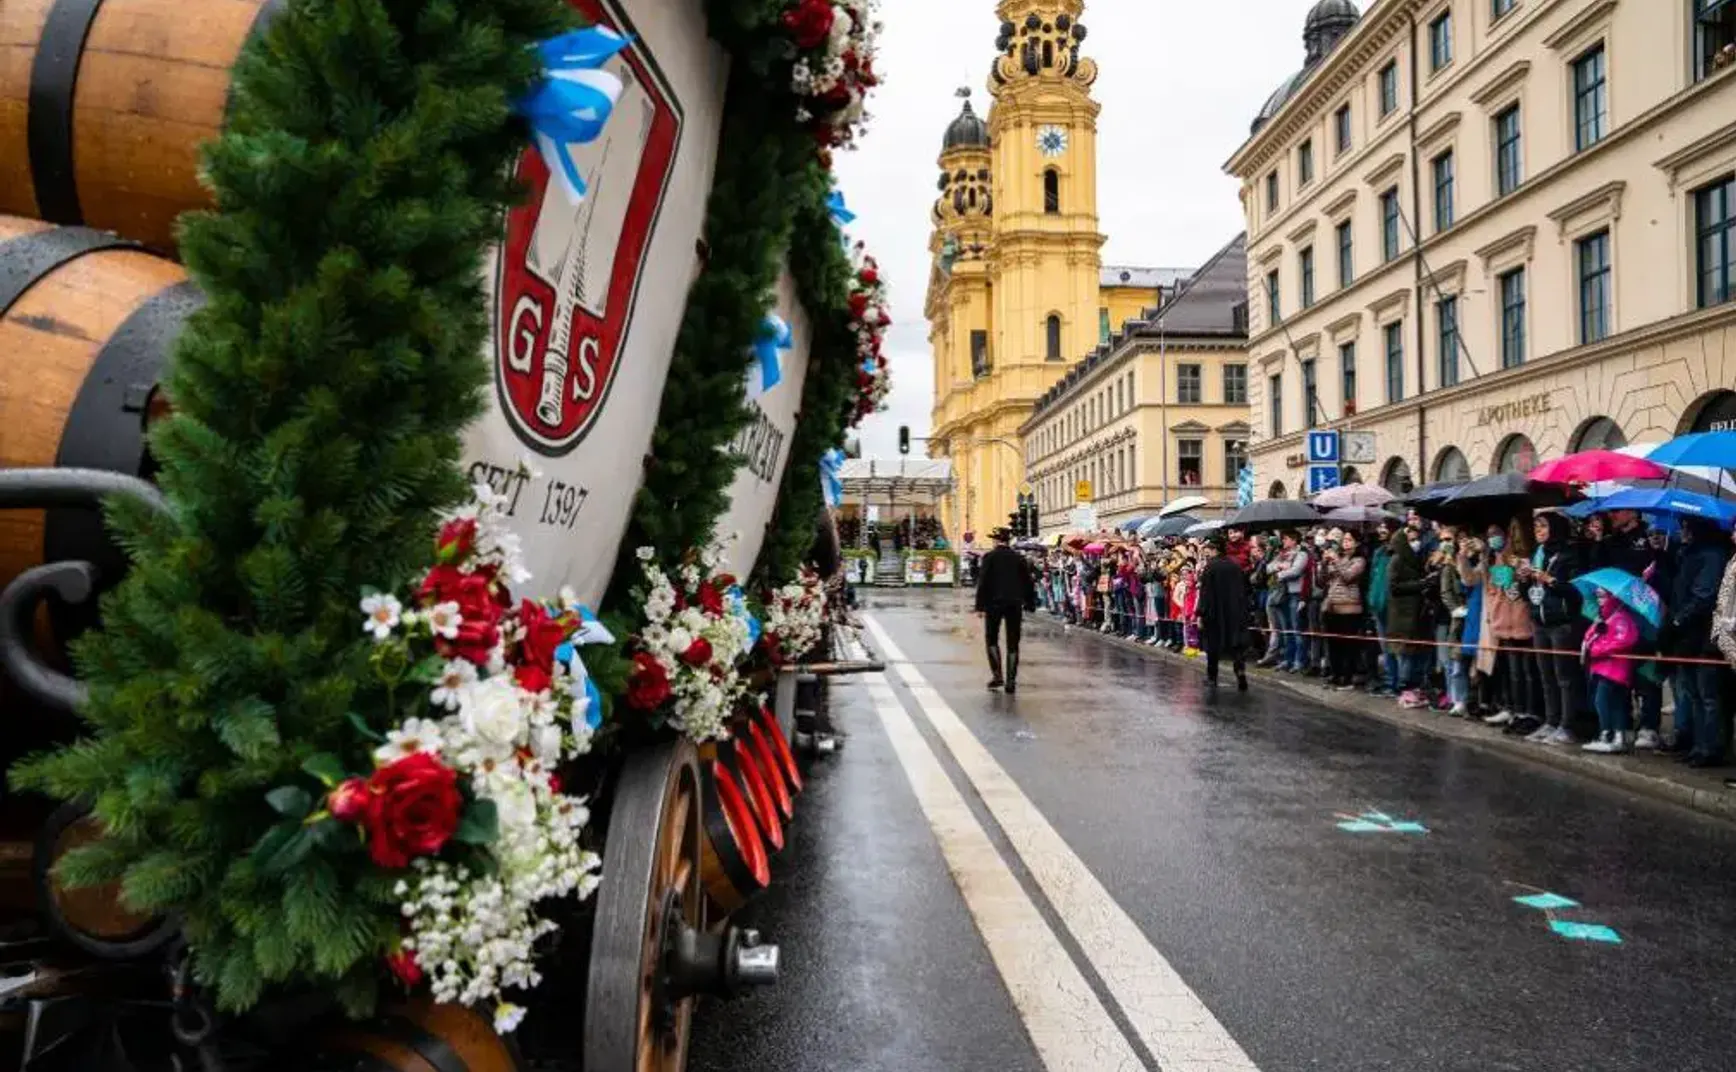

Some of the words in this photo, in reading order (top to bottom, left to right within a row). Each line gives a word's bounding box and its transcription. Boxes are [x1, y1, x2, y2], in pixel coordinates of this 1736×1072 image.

[508, 295, 542, 374] G
[572, 336, 599, 401] S
[1478, 392, 1550, 426] APOTHEKE
[1315, 435, 1332, 457] U
[468, 461, 531, 516] SEIT
[539, 480, 588, 530] 1397
